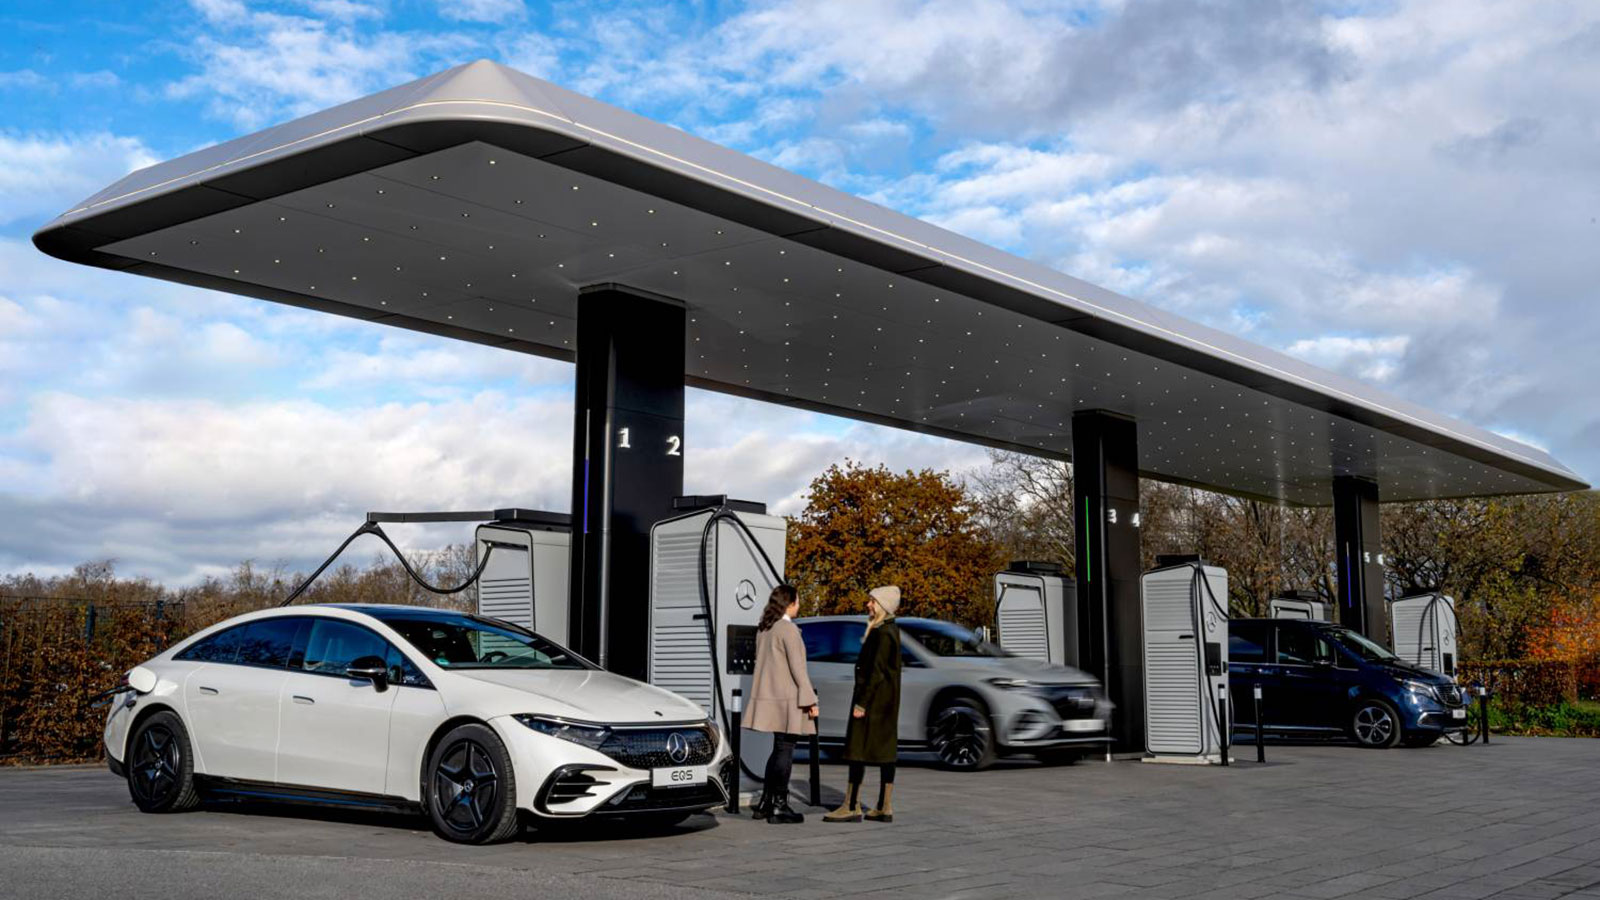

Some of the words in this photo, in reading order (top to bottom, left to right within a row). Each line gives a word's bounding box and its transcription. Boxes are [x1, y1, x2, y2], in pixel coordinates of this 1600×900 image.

[618, 427, 631, 448] 1
[666, 435, 681, 456] 2
[1107, 508, 1117, 524] 3
[1132, 512, 1140, 528] 4
[671, 769, 693, 781] EQS
